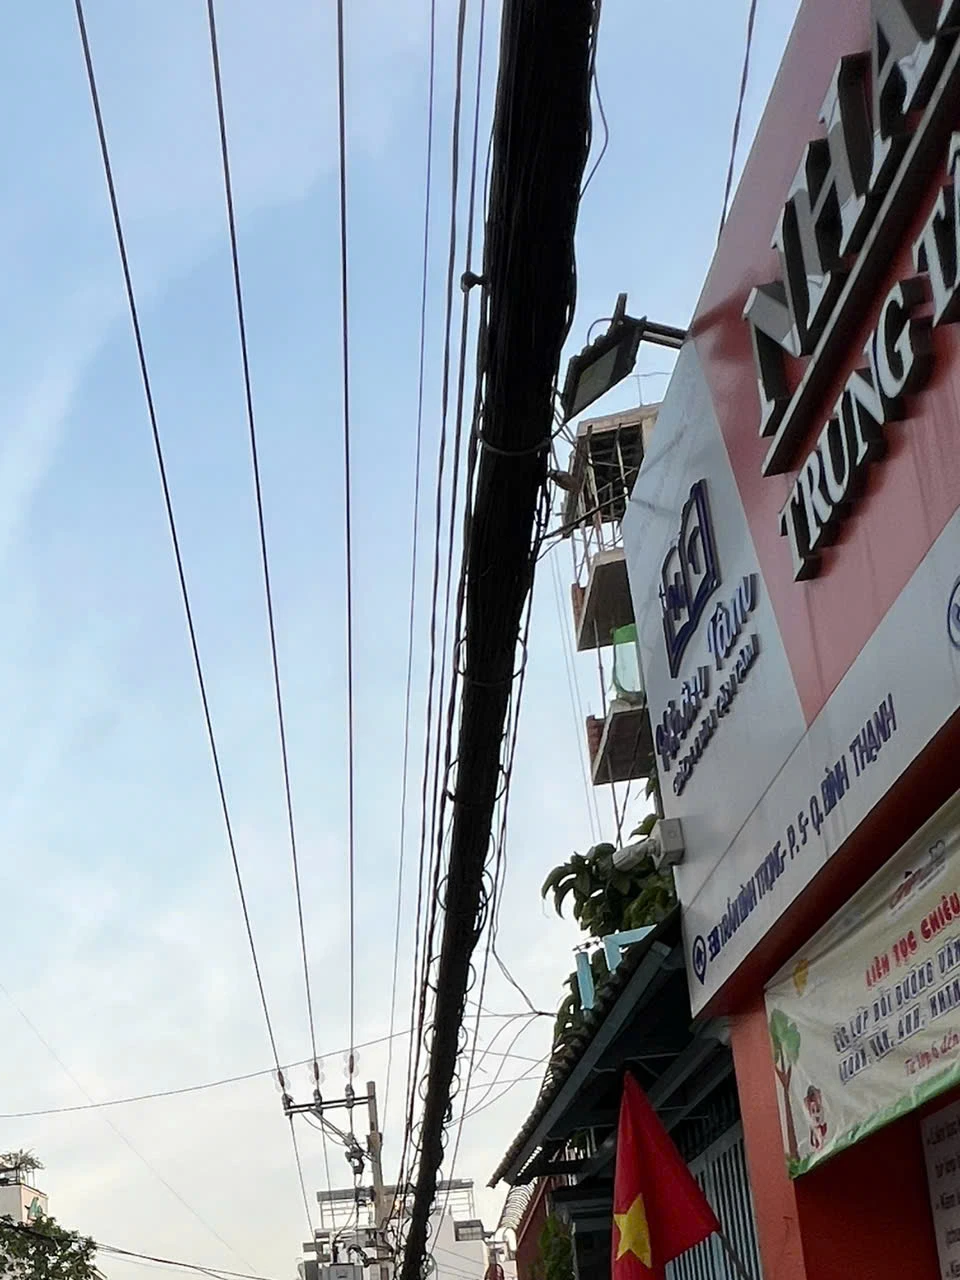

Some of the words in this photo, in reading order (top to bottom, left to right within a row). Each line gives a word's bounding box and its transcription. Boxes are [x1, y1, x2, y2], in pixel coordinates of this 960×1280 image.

[778, 281, 918, 582] TRUNG
[849, 692, 897, 777] THẠNH
[866, 953, 890, 989] LIÊN
[893, 930, 918, 966] TỤC
